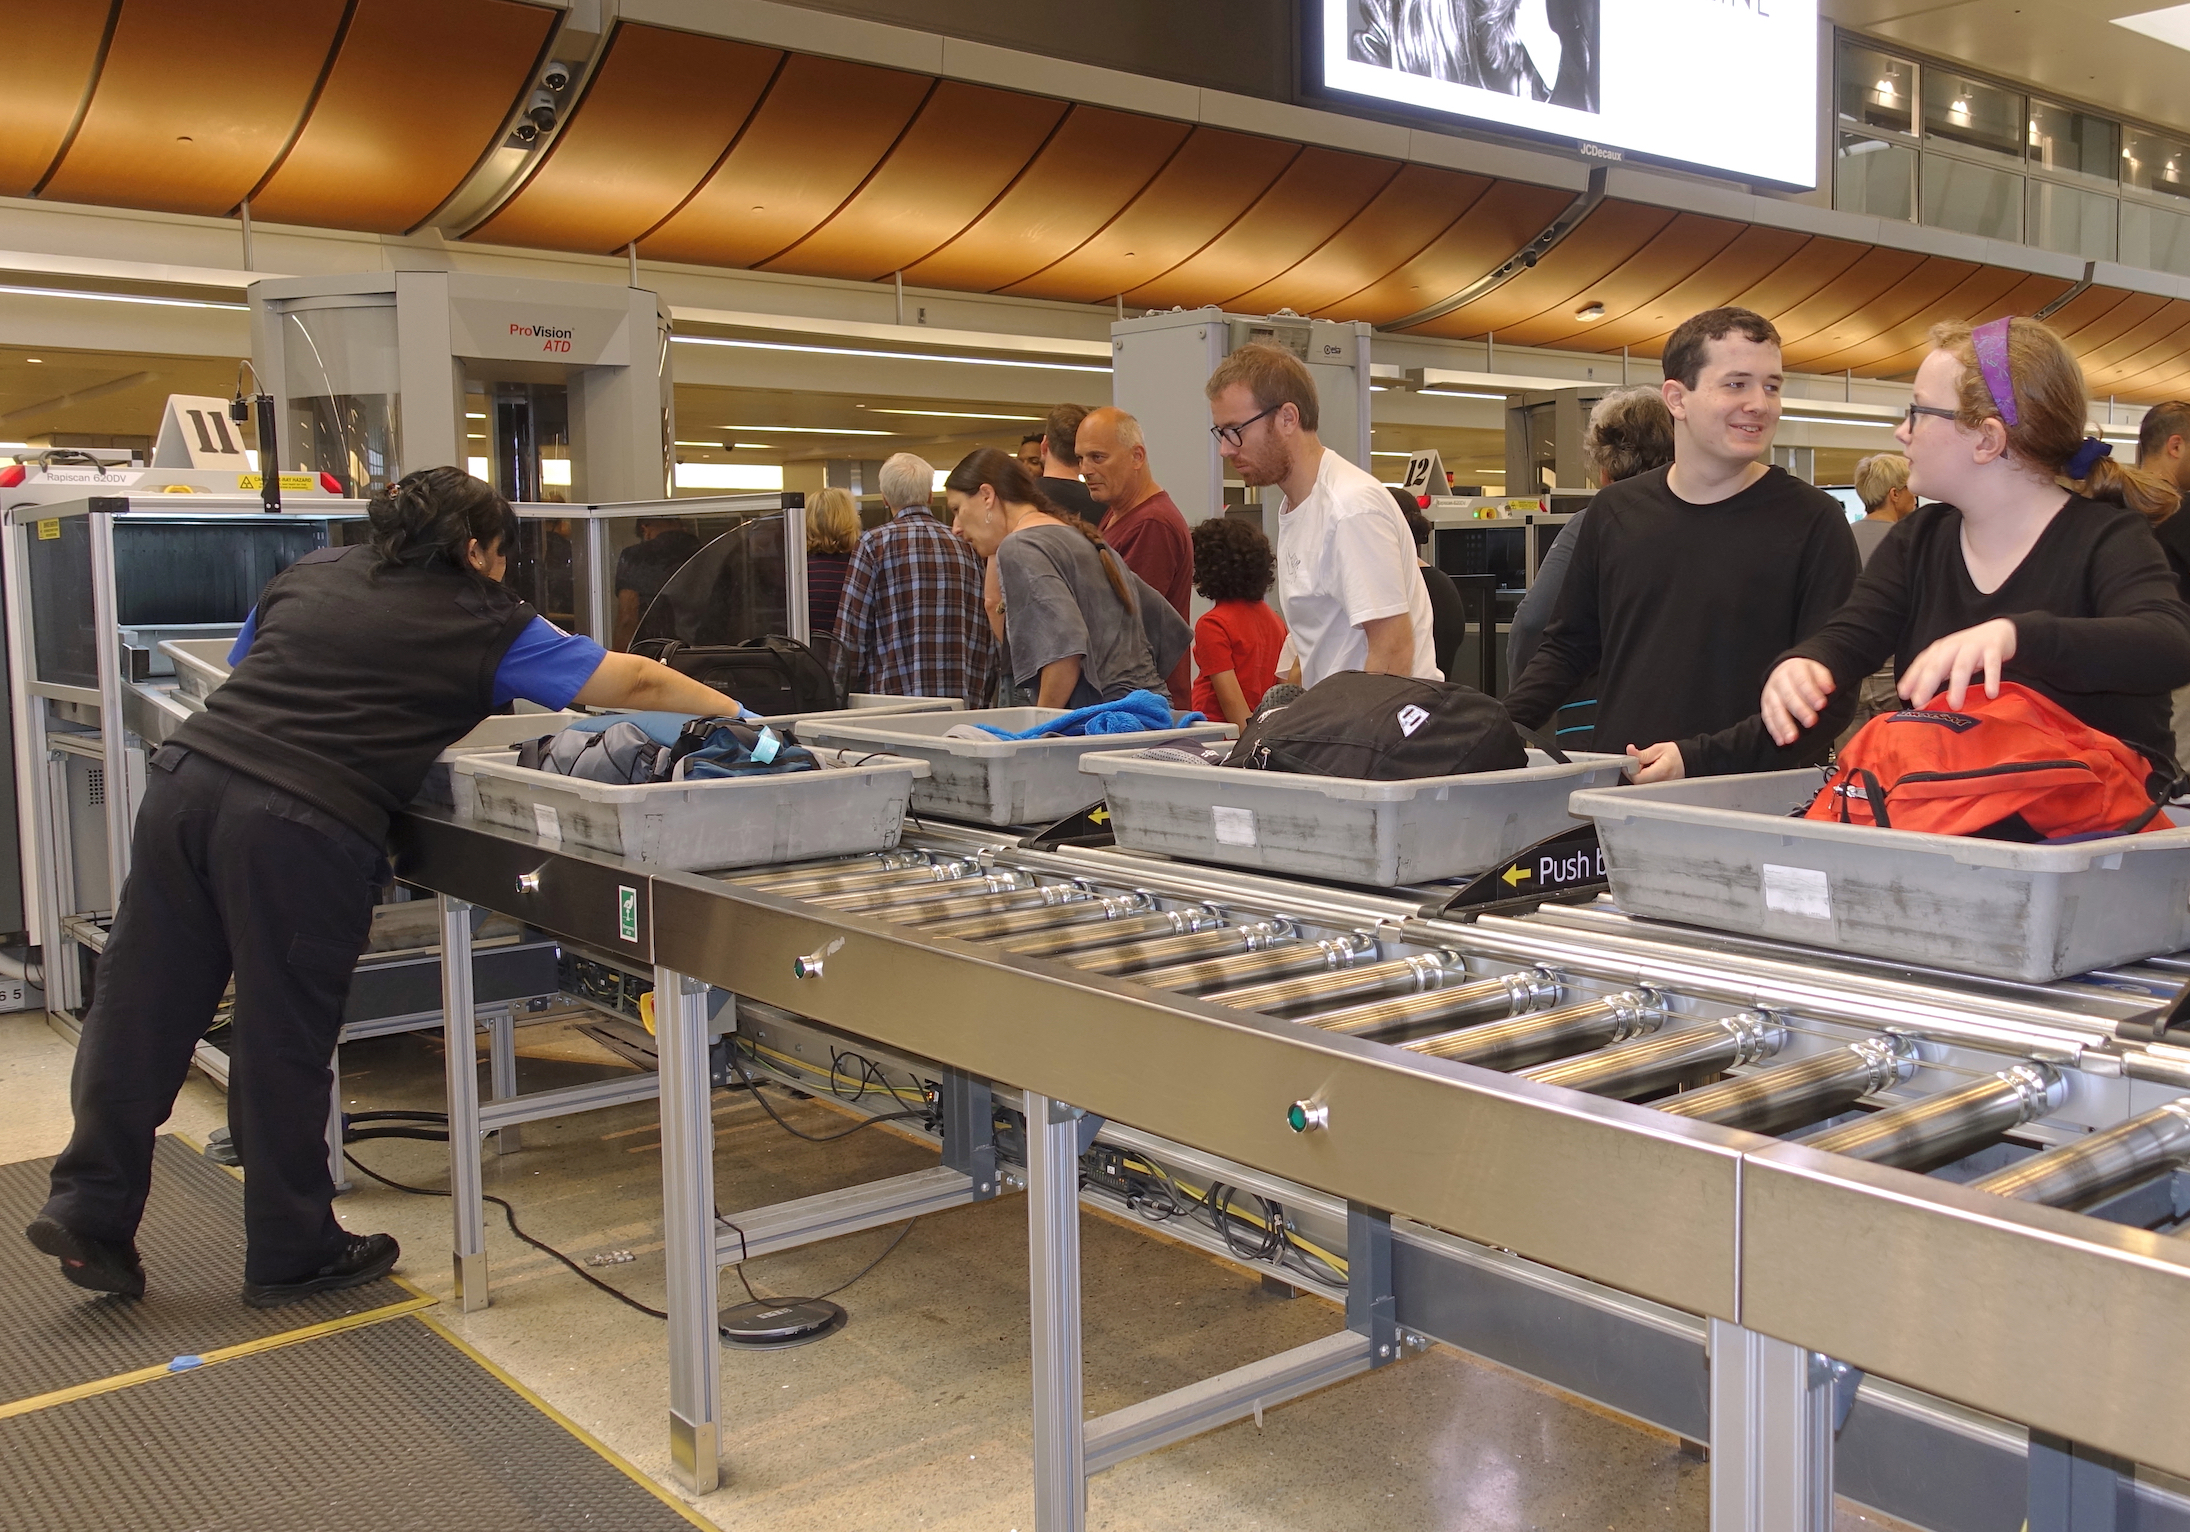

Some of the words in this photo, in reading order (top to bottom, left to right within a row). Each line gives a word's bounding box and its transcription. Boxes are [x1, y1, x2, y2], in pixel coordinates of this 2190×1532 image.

[1581, 143, 1622, 161] JCDecaux
[510, 324, 572, 339] ProVision
[543, 340, 571, 353] ATD
[186, 410, 239, 454] 11
[47, 473, 90, 483] Rapiscan
[93, 474, 127, 483] 620DV
[1404, 458, 1429, 487] 12
[1540, 850, 1589, 885] Push
